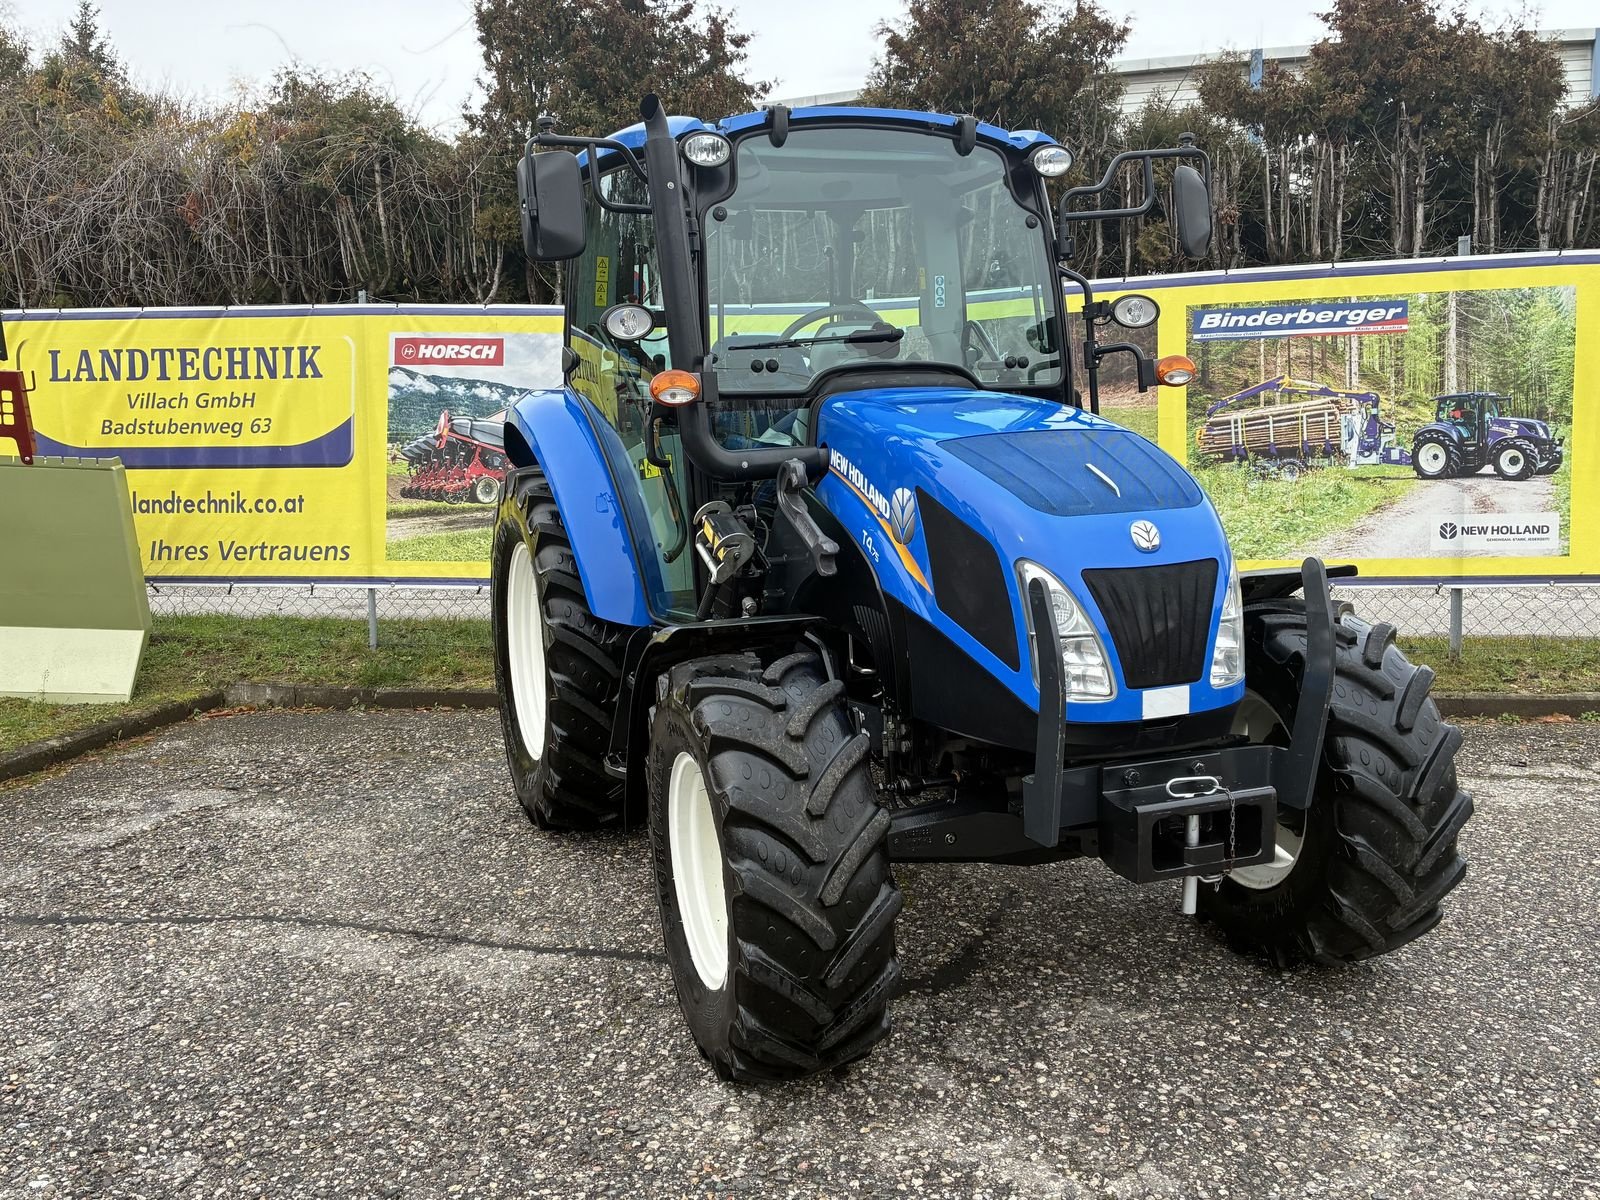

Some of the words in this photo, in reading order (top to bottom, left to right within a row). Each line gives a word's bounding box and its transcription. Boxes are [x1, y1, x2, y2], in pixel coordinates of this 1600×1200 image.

[1199, 306, 1403, 329] Binderberger
[418, 344, 497, 359] HORSCH
[48, 345, 323, 382] LANDTECHNIK
[127, 392, 189, 410] Villach
[195, 392, 256, 409] GmbH
[101, 418, 243, 438] Badstubenweg
[250, 417, 272, 433] 63
[830, 448, 848, 475] NEW
[848, 462, 890, 519] HOLLAND
[132, 490, 304, 514] landtechnik.co.at
[1461, 526, 1488, 536] NEW
[1491, 525, 1550, 535] HOLLAND
[150, 539, 209, 561] Ihres
[218, 540, 351, 562] Vertrauens
